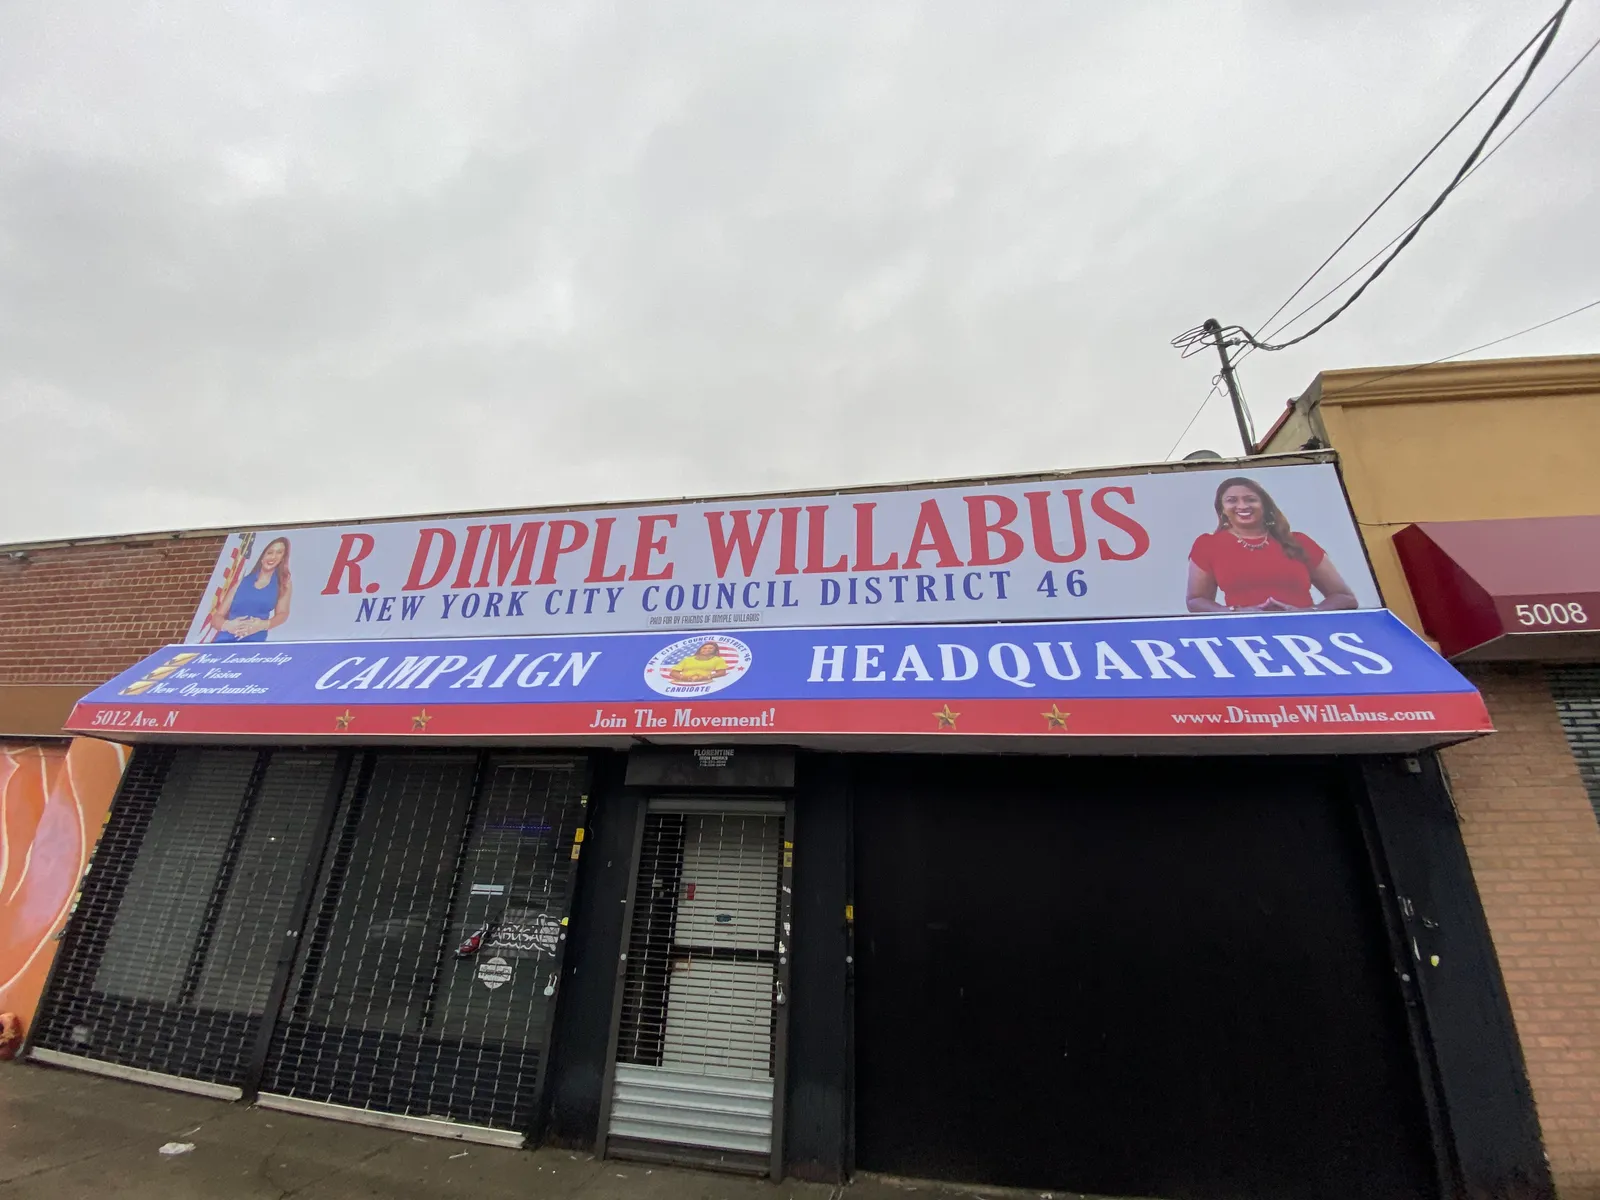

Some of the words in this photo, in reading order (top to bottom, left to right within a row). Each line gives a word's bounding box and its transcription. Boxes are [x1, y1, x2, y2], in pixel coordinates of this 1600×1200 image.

[320, 533, 380, 595] R.
[401, 513, 678, 592] DIMPLE
[704, 486, 1151, 579] WILLABUS
[355, 595, 425, 622] NEW
[440, 590, 529, 619] YORK
[544, 587, 625, 616] CITY
[642, 579, 799, 612] COUNCIL
[820, 570, 1011, 606] DISTRICT
[1036, 569, 1089, 599] 46
[662, 616, 673, 625] FOR
[681, 614, 704, 624] FRIENDS
[704, 614, 711, 623] OF
[1514, 602, 1588, 626] 5008
[192, 653, 222, 664] New
[221, 652, 293, 666] Leadership
[648, 656, 660, 666] NY
[661, 644, 679, 656] CITY
[682, 636, 715, 646] COUNCIL
[718, 636, 747, 652] DISTRICT
[807, 631, 1394, 688] HEADQUARTERS
[170, 668, 200, 679] New
[202, 667, 243, 679] Vision
[314, 651, 603, 691] CAMPAIGN
[147, 682, 179, 694] New
[179, 682, 269, 697] Opportunities
[665, 685, 711, 693] CANDIDATE
[92, 710, 131, 727] 5012
[130, 710, 159, 727] Ave.
[163, 711, 180, 727] N
[590, 709, 627, 729] Join
[634, 708, 667, 728] The
[672, 707, 776, 728] Movement!
[1171, 703, 1436, 729] www.DimpleWillabus.com
